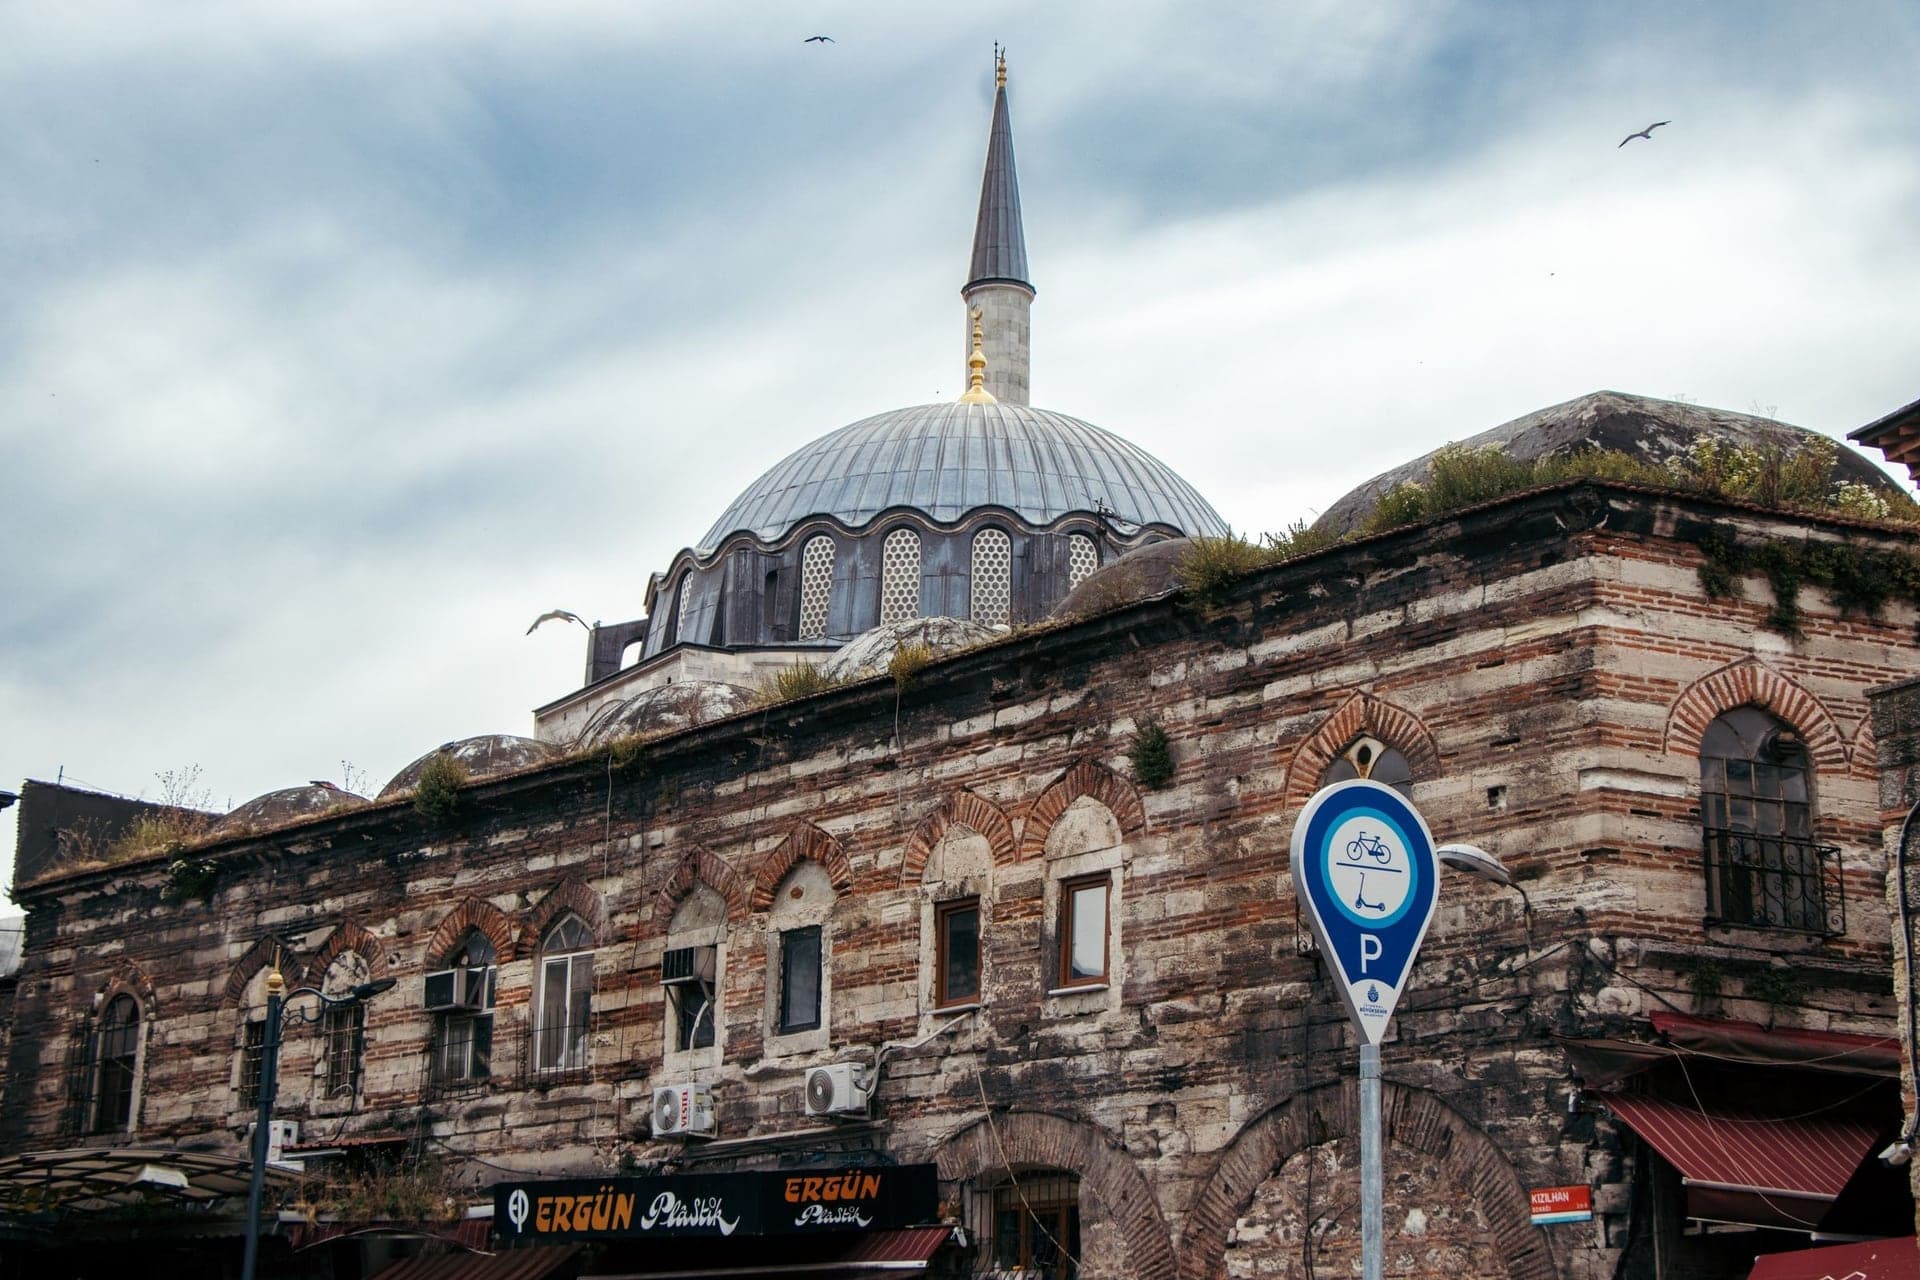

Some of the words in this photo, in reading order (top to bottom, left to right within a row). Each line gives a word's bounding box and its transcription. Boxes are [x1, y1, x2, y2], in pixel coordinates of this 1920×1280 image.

[1360, 933, 1382, 974] P
[680, 1088, 689, 1128] VESTEL
[784, 1169, 881, 1203] ERGÜN
[1531, 1191, 1569, 1204] KIZILHAN
[535, 1185, 635, 1233] ERGÜN
